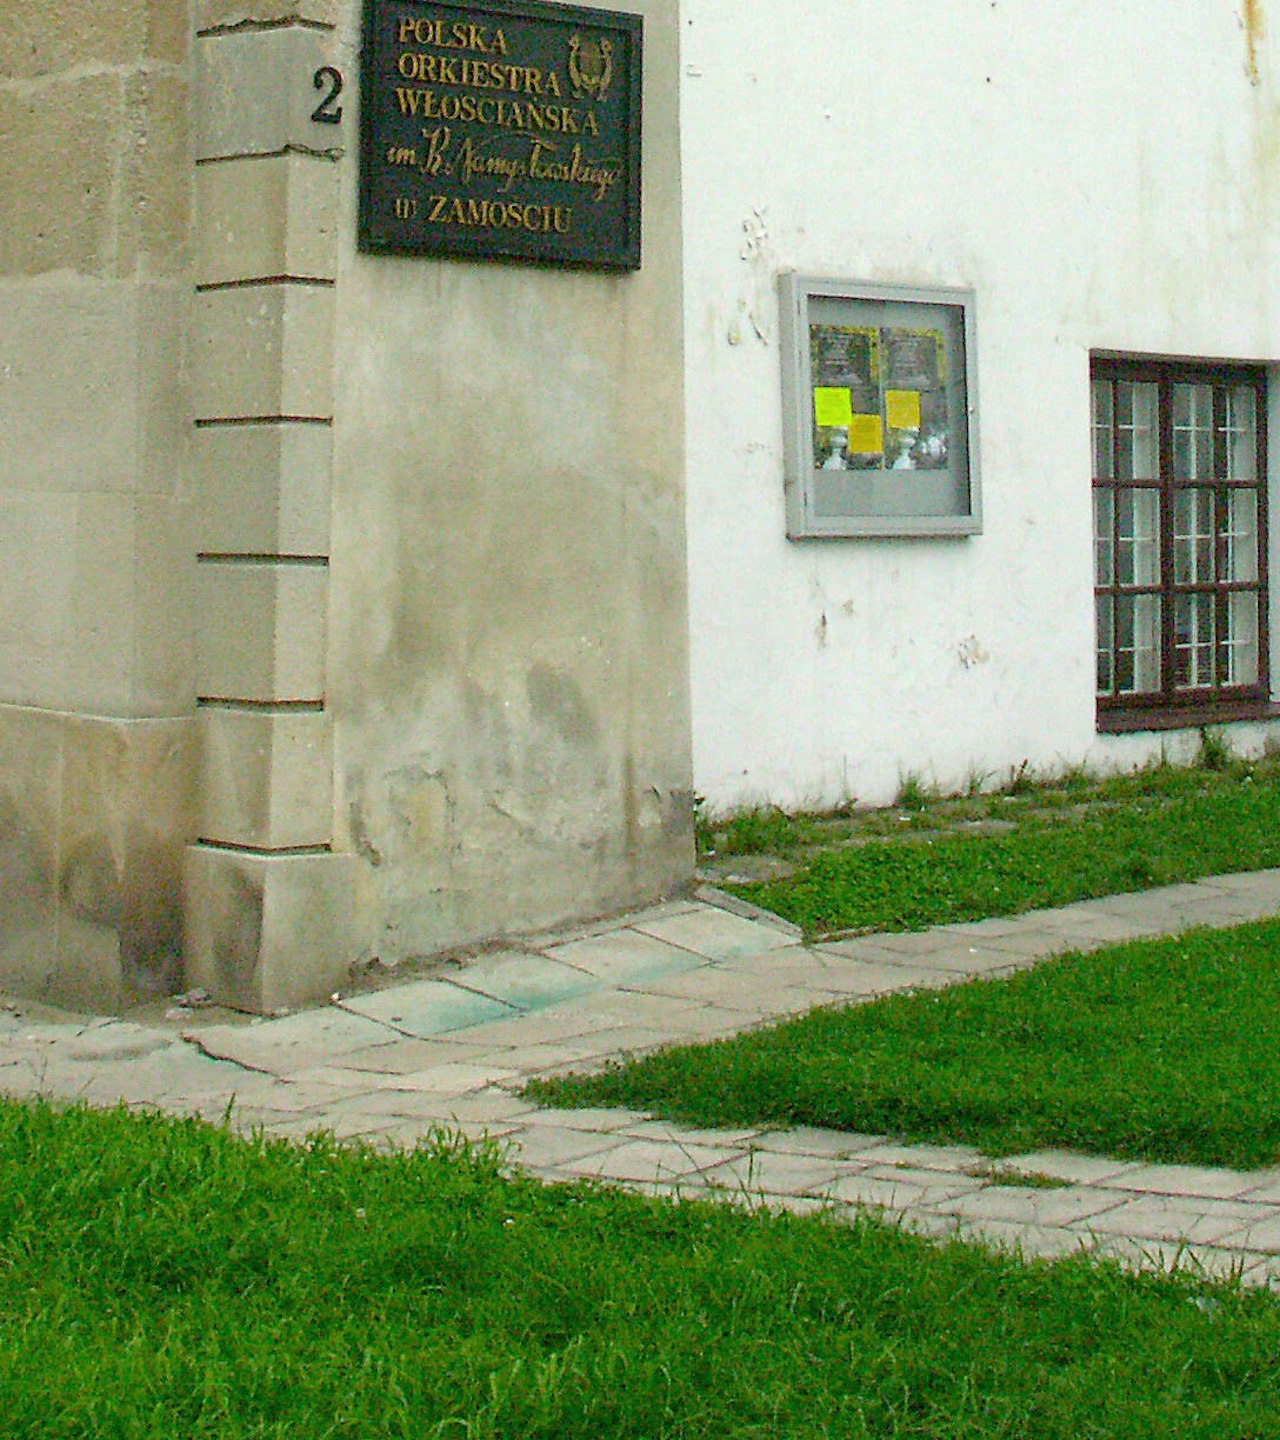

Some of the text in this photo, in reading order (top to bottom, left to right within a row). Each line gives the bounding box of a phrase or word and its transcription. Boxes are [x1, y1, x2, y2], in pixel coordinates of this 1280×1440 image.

[398, 16, 508, 55] POLSKA
[311, 66, 343, 124] 2
[398, 52, 561, 97] ORKIESTRA
